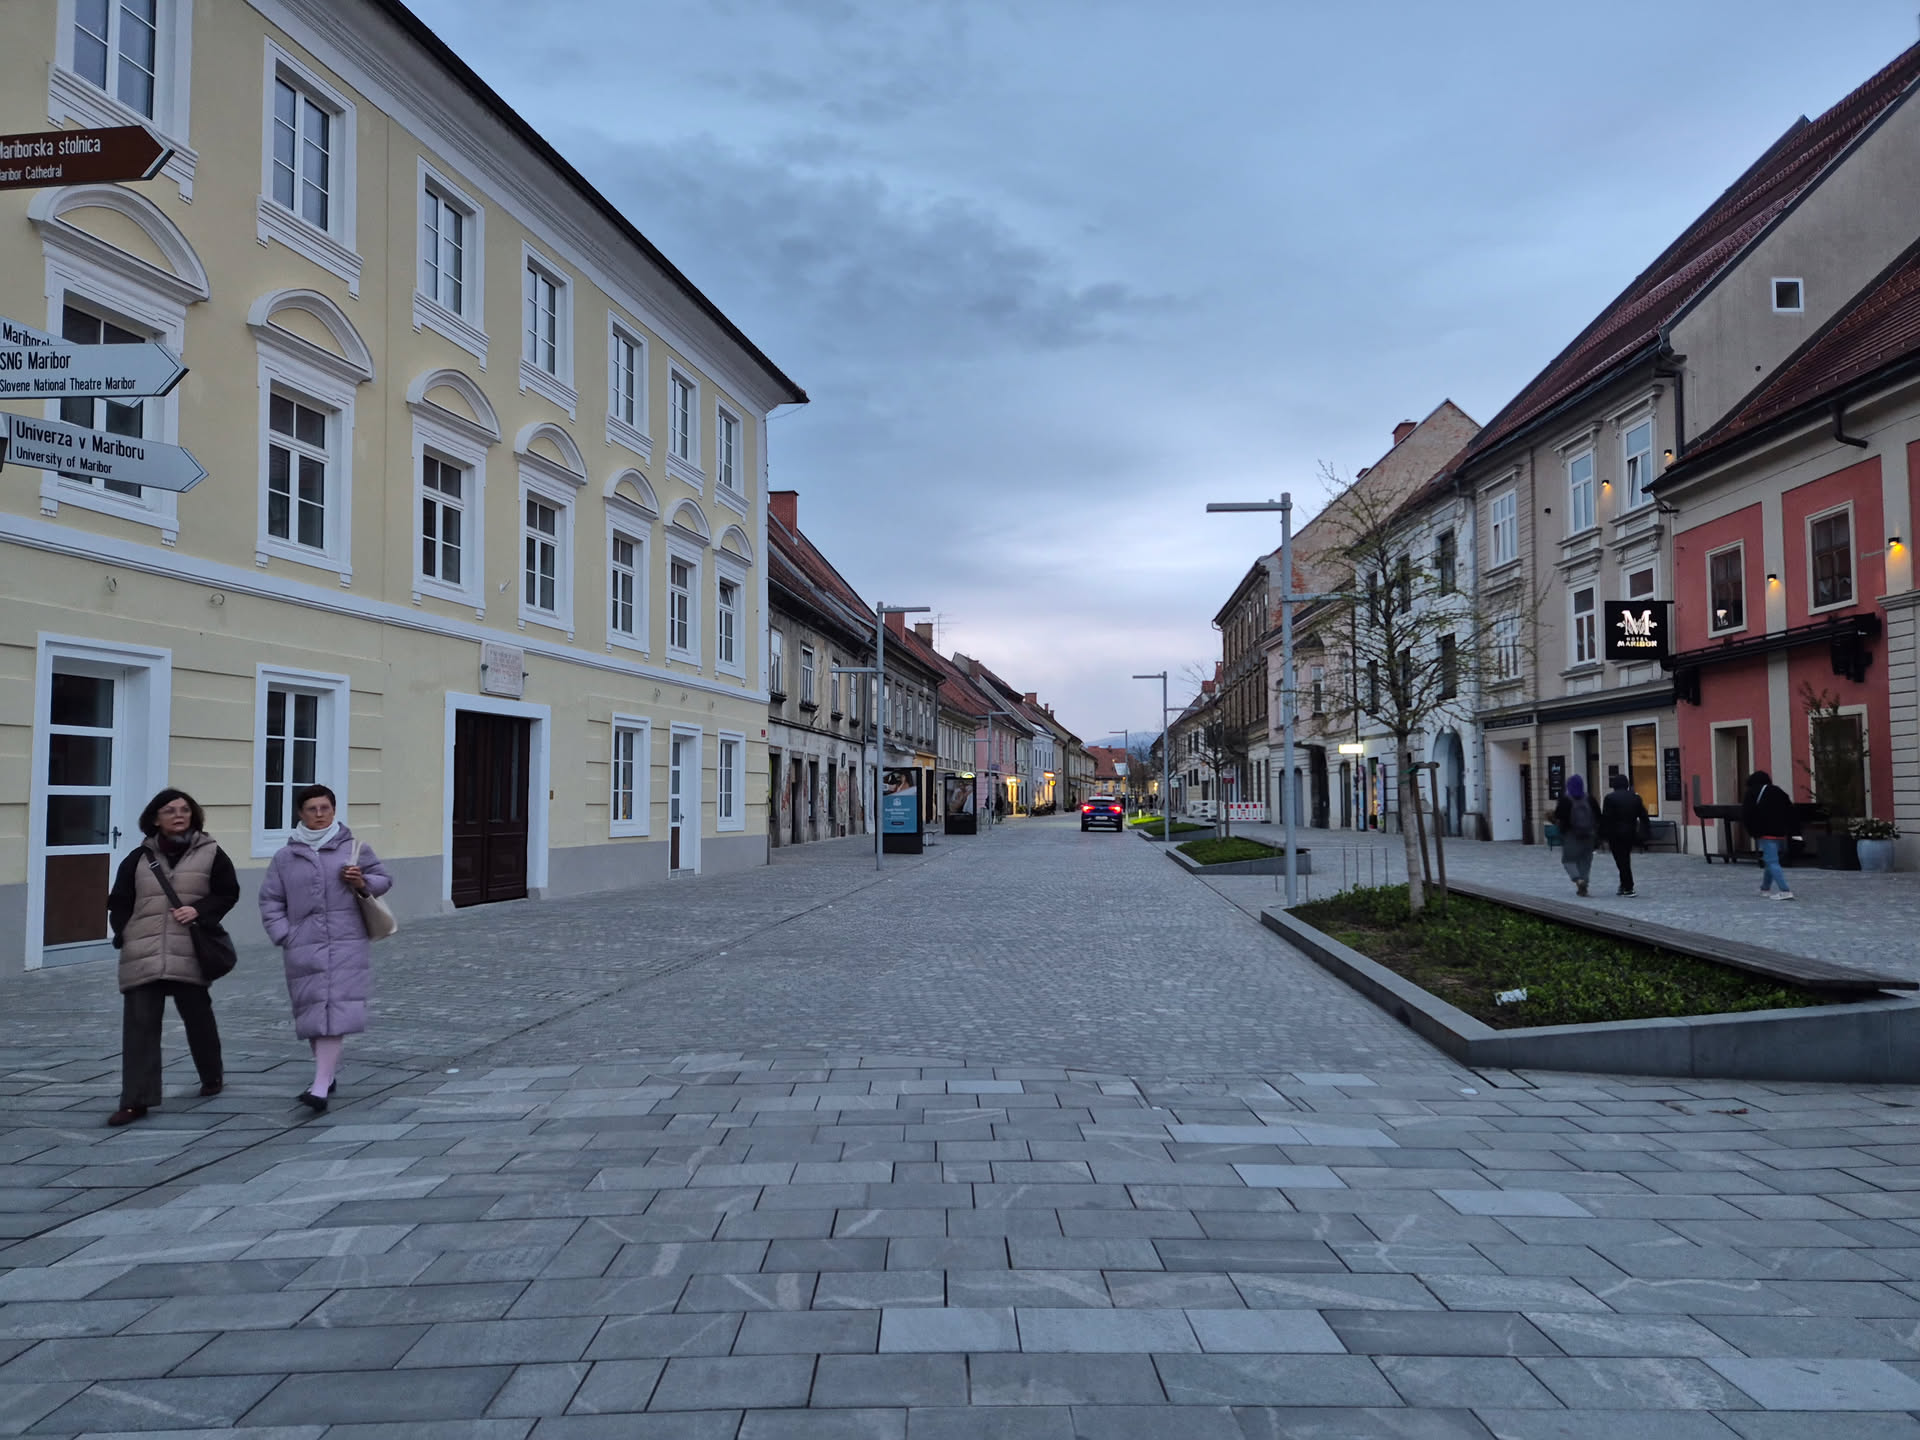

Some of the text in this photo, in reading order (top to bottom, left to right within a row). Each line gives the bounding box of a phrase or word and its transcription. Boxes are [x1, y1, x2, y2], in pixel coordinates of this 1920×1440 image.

[58, 135, 101, 155] stolnica
[0, 163, 62, 181] aribor Cathedral
[0, 351, 71, 370] SNG Maribor
[0, 377, 136, 392] Slovene National Theatre Maribor
[16, 420, 144, 460] Univerza v Mariboru
[16, 446, 112, 474] University of Maribor
